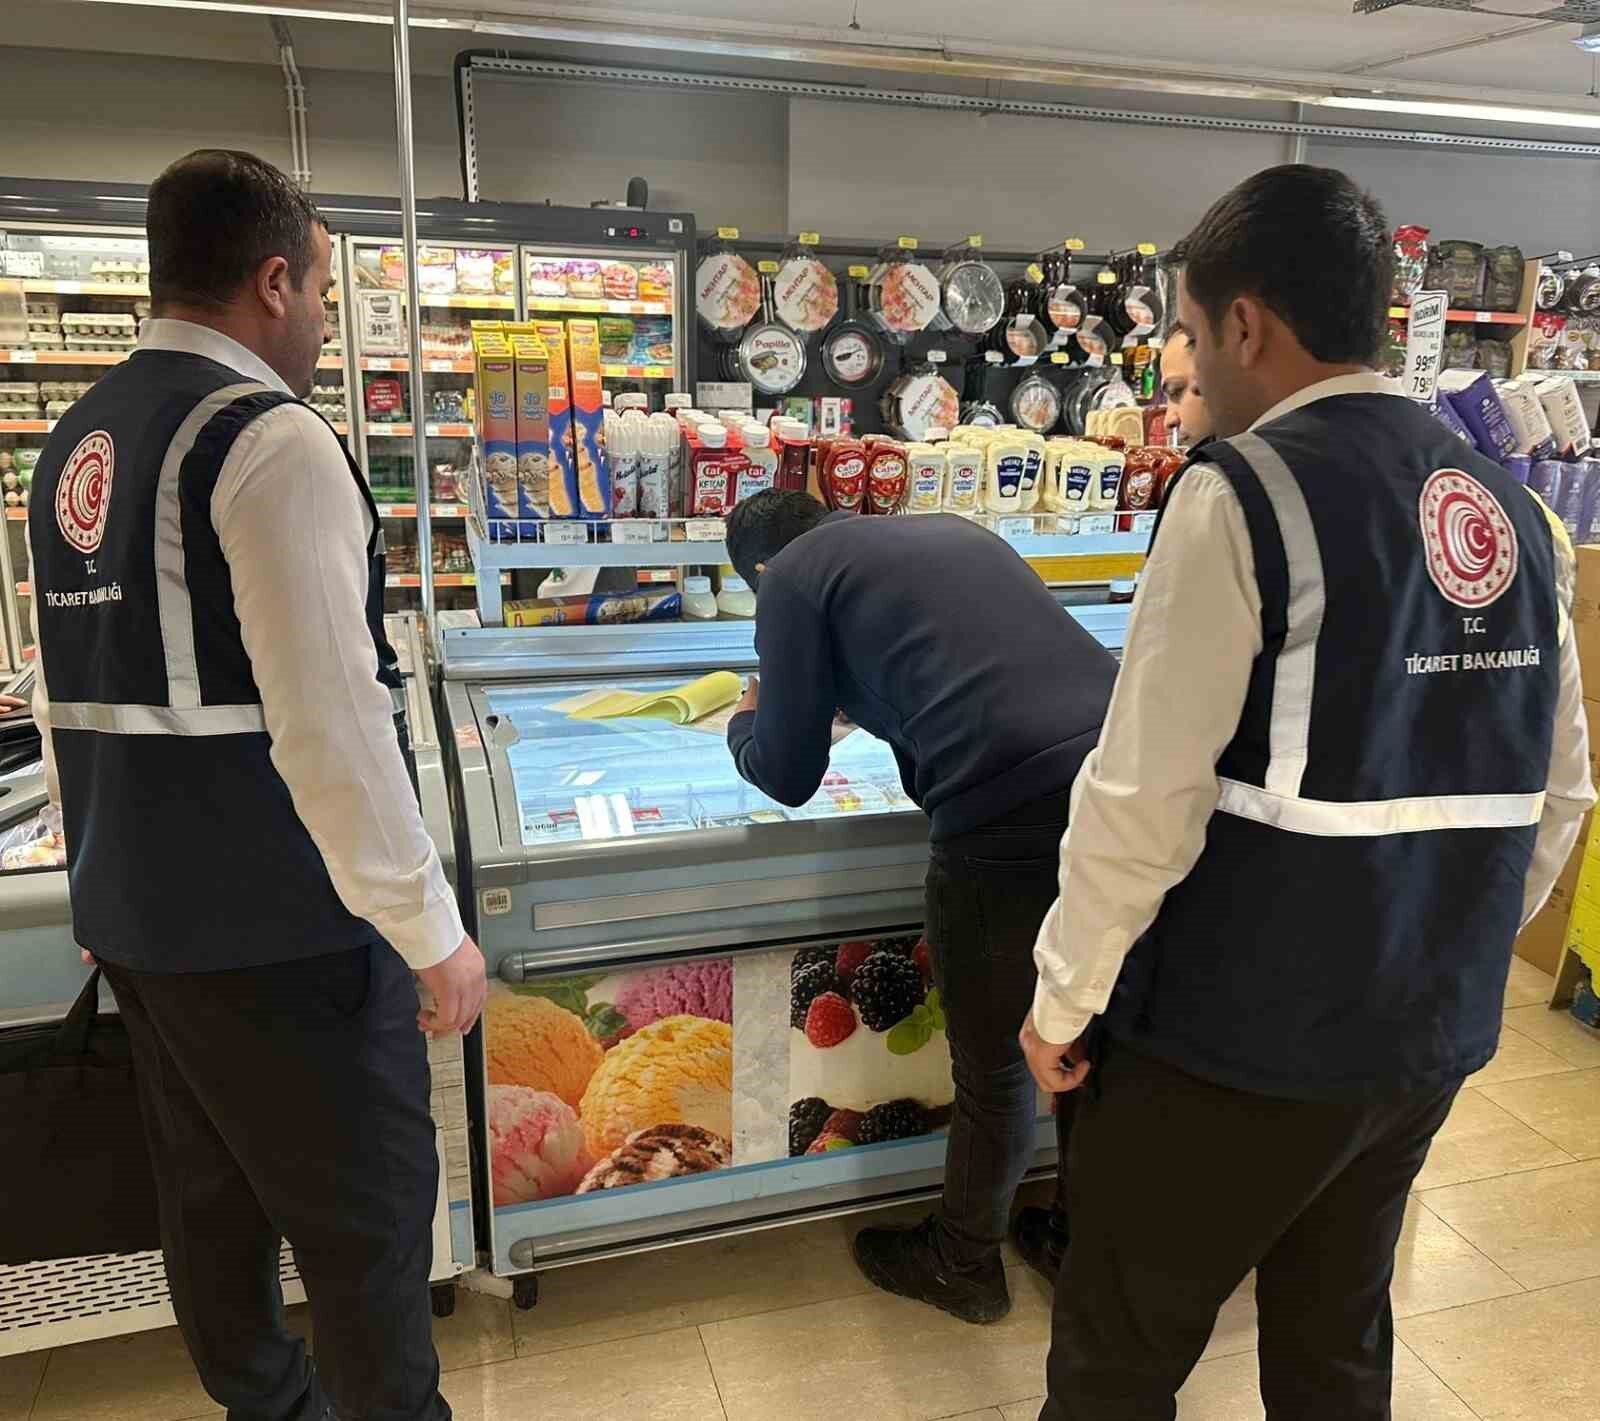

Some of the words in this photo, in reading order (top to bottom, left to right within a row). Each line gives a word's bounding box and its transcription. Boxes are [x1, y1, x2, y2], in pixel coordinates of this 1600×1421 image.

[1412, 377, 1425, 393] 79
[45, 590, 88, 607] TİCARET
[1463, 617, 1486, 634] T.C.
[1405, 653, 1460, 674] TİCARET
[1462, 645, 1541, 670] BAKANLIĞI
